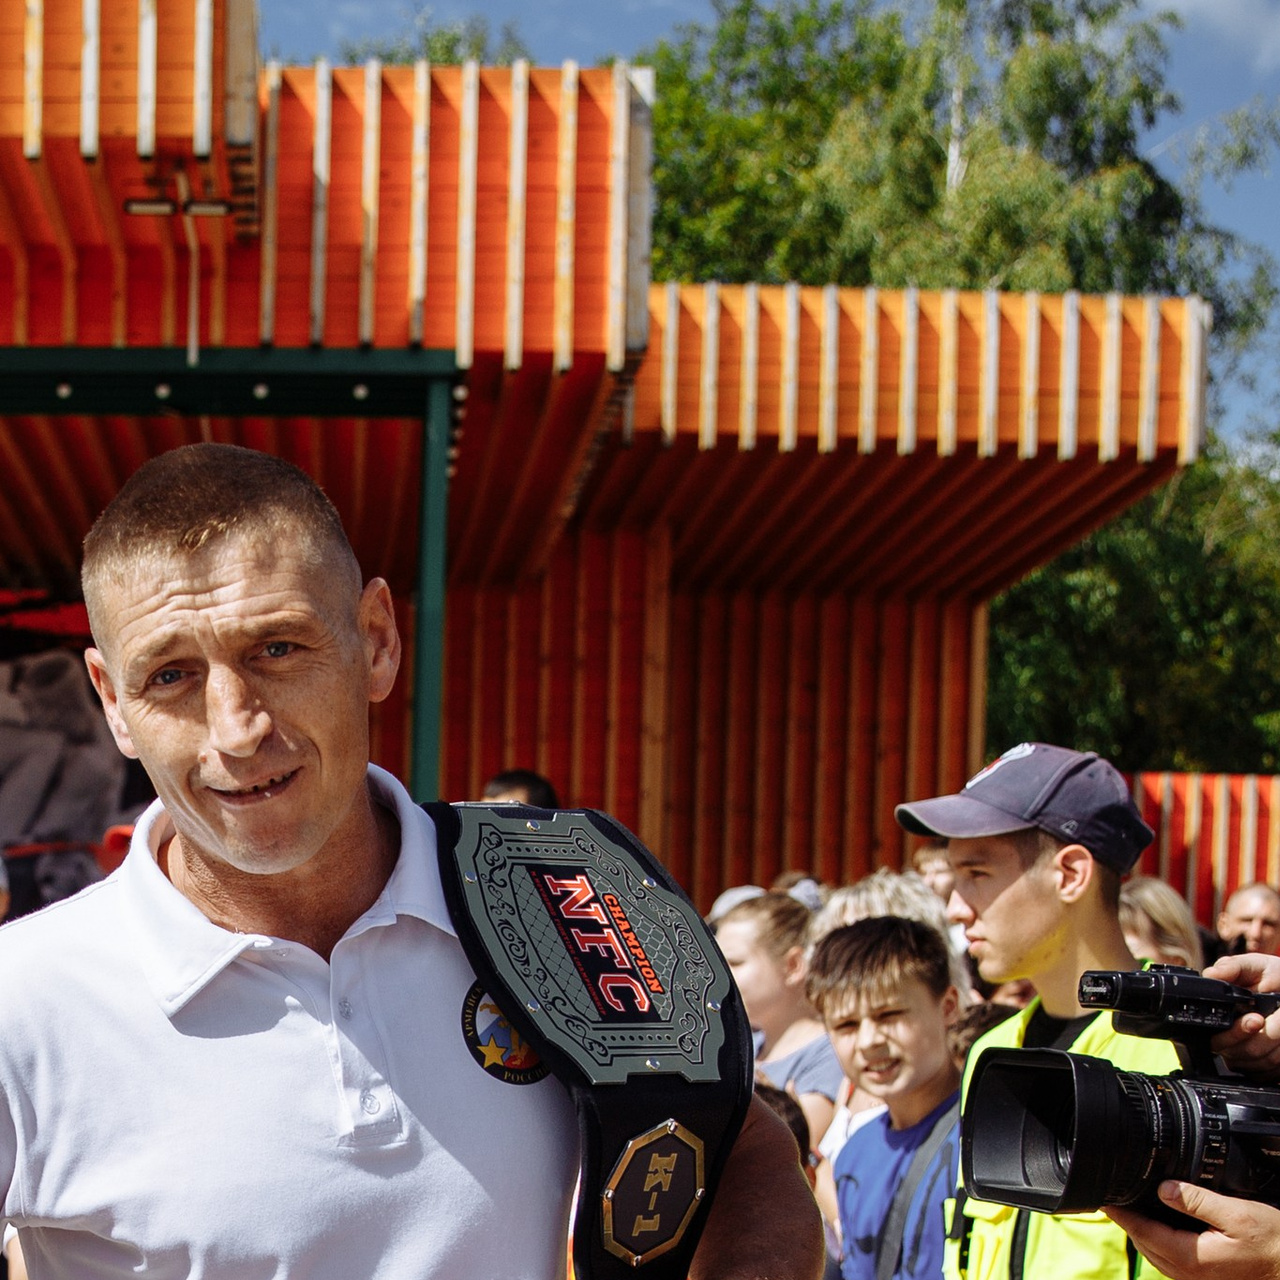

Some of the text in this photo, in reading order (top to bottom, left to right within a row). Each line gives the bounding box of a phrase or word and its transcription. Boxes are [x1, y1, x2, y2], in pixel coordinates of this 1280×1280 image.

[543, 874, 651, 1012] NFC
[603, 893, 665, 993] CHAMPION
[632, 1153, 677, 1236] K-1
